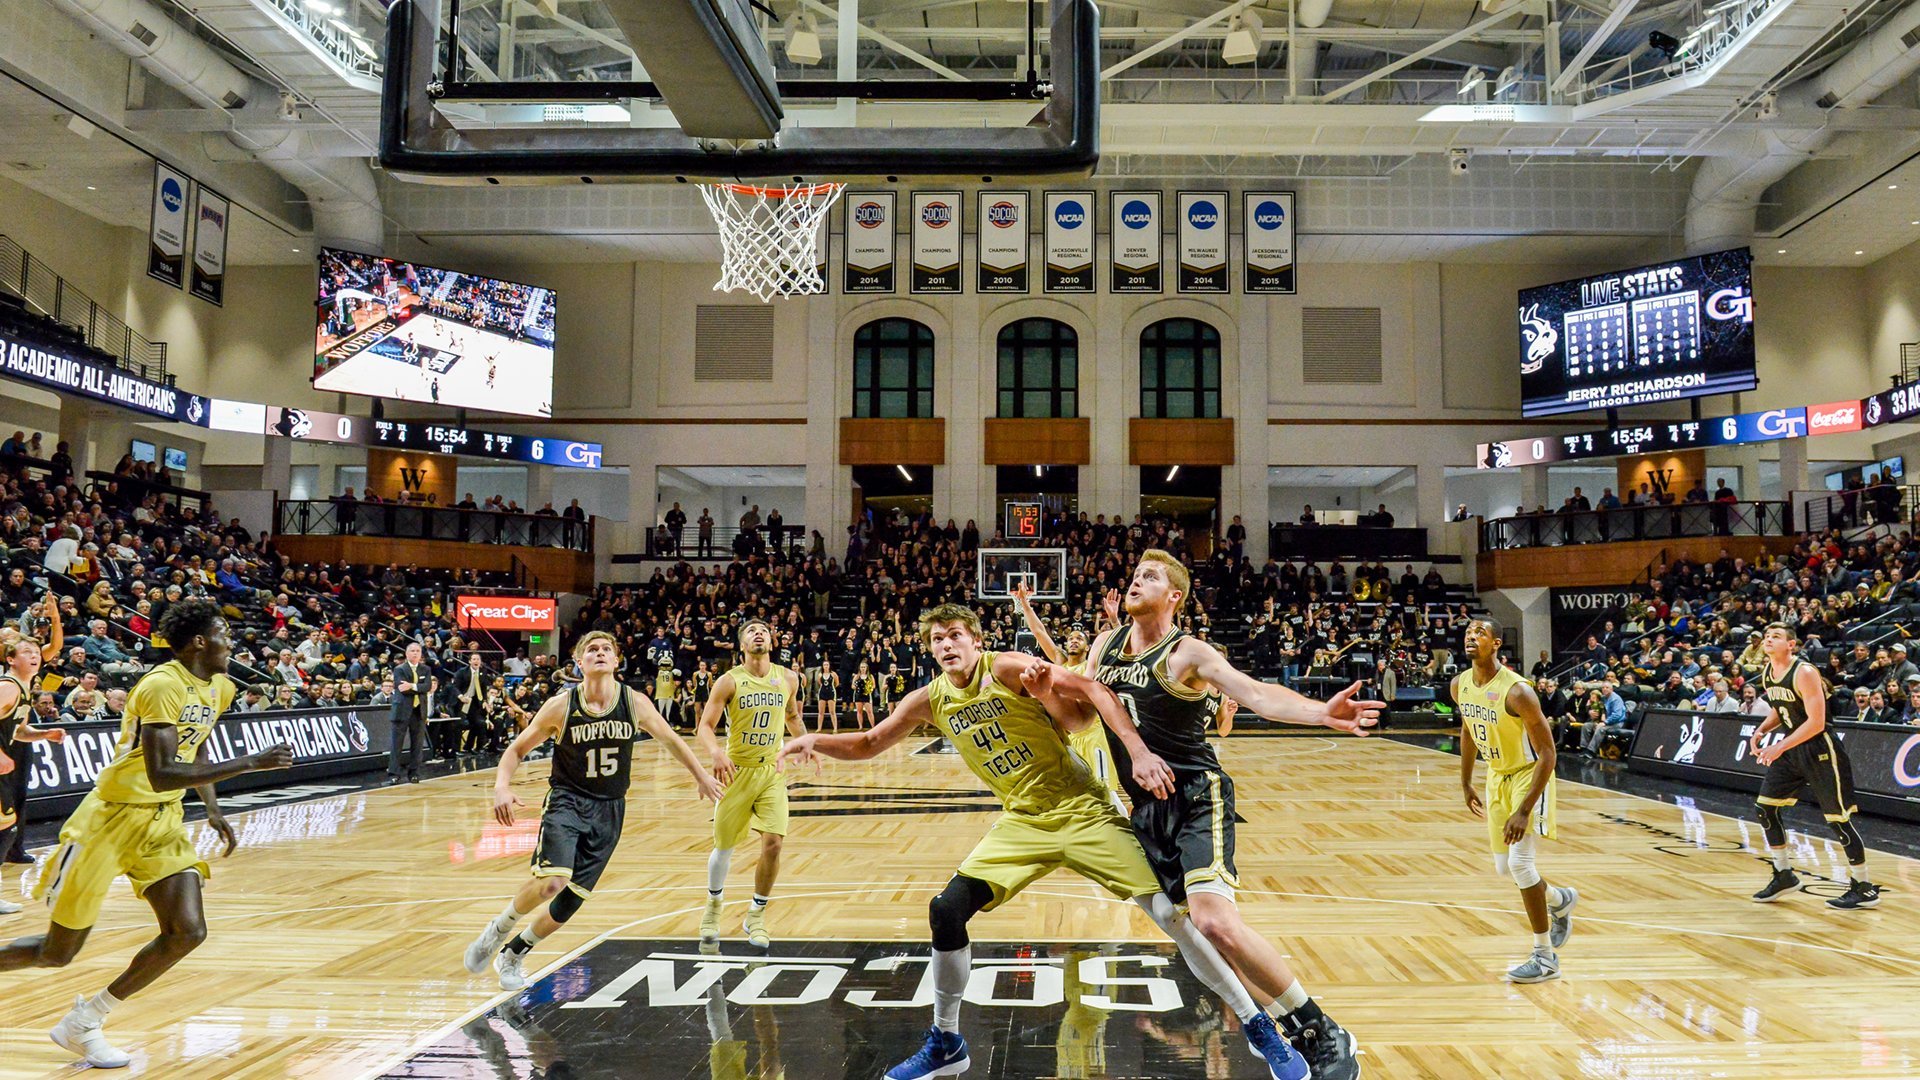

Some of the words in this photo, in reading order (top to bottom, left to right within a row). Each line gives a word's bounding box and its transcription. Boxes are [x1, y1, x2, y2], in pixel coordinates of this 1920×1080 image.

[856, 206, 885, 222] SOCON
[922, 206, 952, 222] SOCON
[989, 206, 1018, 222] SOCON
[1058, 214, 1084, 223] NCAA
[1125, 214, 1151, 223] NCAA
[1191, 214, 1217, 223] NCAA
[1257, 215, 1283, 223] NCAA
[1581, 277, 1620, 308] LIVE
[1623, 266, 1683, 299] STATS
[7, 343, 81, 387] ACADEMIC
[81, 365, 176, 415] ALL-AMERICANS
[1565, 386, 1608, 403] JERRY
[1610, 373, 1706, 396] RICHARDSON
[1588, 396, 1630, 409] INDOOR
[1633, 390, 1680, 404] STADIUM
[1891, 389, 1907, 415] 33
[1810, 408, 1857, 428] Coca-Cola
[338, 417, 351, 440] 0
[380, 430, 387, 441] 2
[398, 432, 406, 443] 4
[425, 427, 468, 445] 15:54
[1611, 427, 1654, 445] 15:54
[1671, 432, 1679, 442] 4
[1688, 430, 1696, 441] 2
[1722, 417, 1738, 440] 6
[440, 443, 453, 454] 1ST
[485, 441, 492, 452] 4
[500, 442, 508, 453] 2
[531, 440, 544, 460] 6
[1532, 440, 1545, 459] 0
[1569, 443, 1576, 453] 2
[1586, 440, 1593, 451] 4
[1627, 445, 1639, 454] 1ST
[399, 467, 427, 491] W
[1646, 469, 1674, 494] W
[1020, 517, 1034, 535] 15
[461, 603, 508, 618] Great
[511, 605, 549, 622] Clips
[739, 692, 784, 709] GEORGIA
[752, 711, 770, 728] 10
[949, 697, 1009, 736] GEORGIA
[570, 720, 633, 744] WOFFORD
[741, 731, 776, 746] TECH
[972, 721, 1008, 752] 44
[1473, 723, 1487, 741] 13
[983, 741, 1034, 778] TECH
[1735, 740, 1747, 761] 0
[585, 747, 619, 778] 15
[560, 952, 1185, 1012] SOCON
